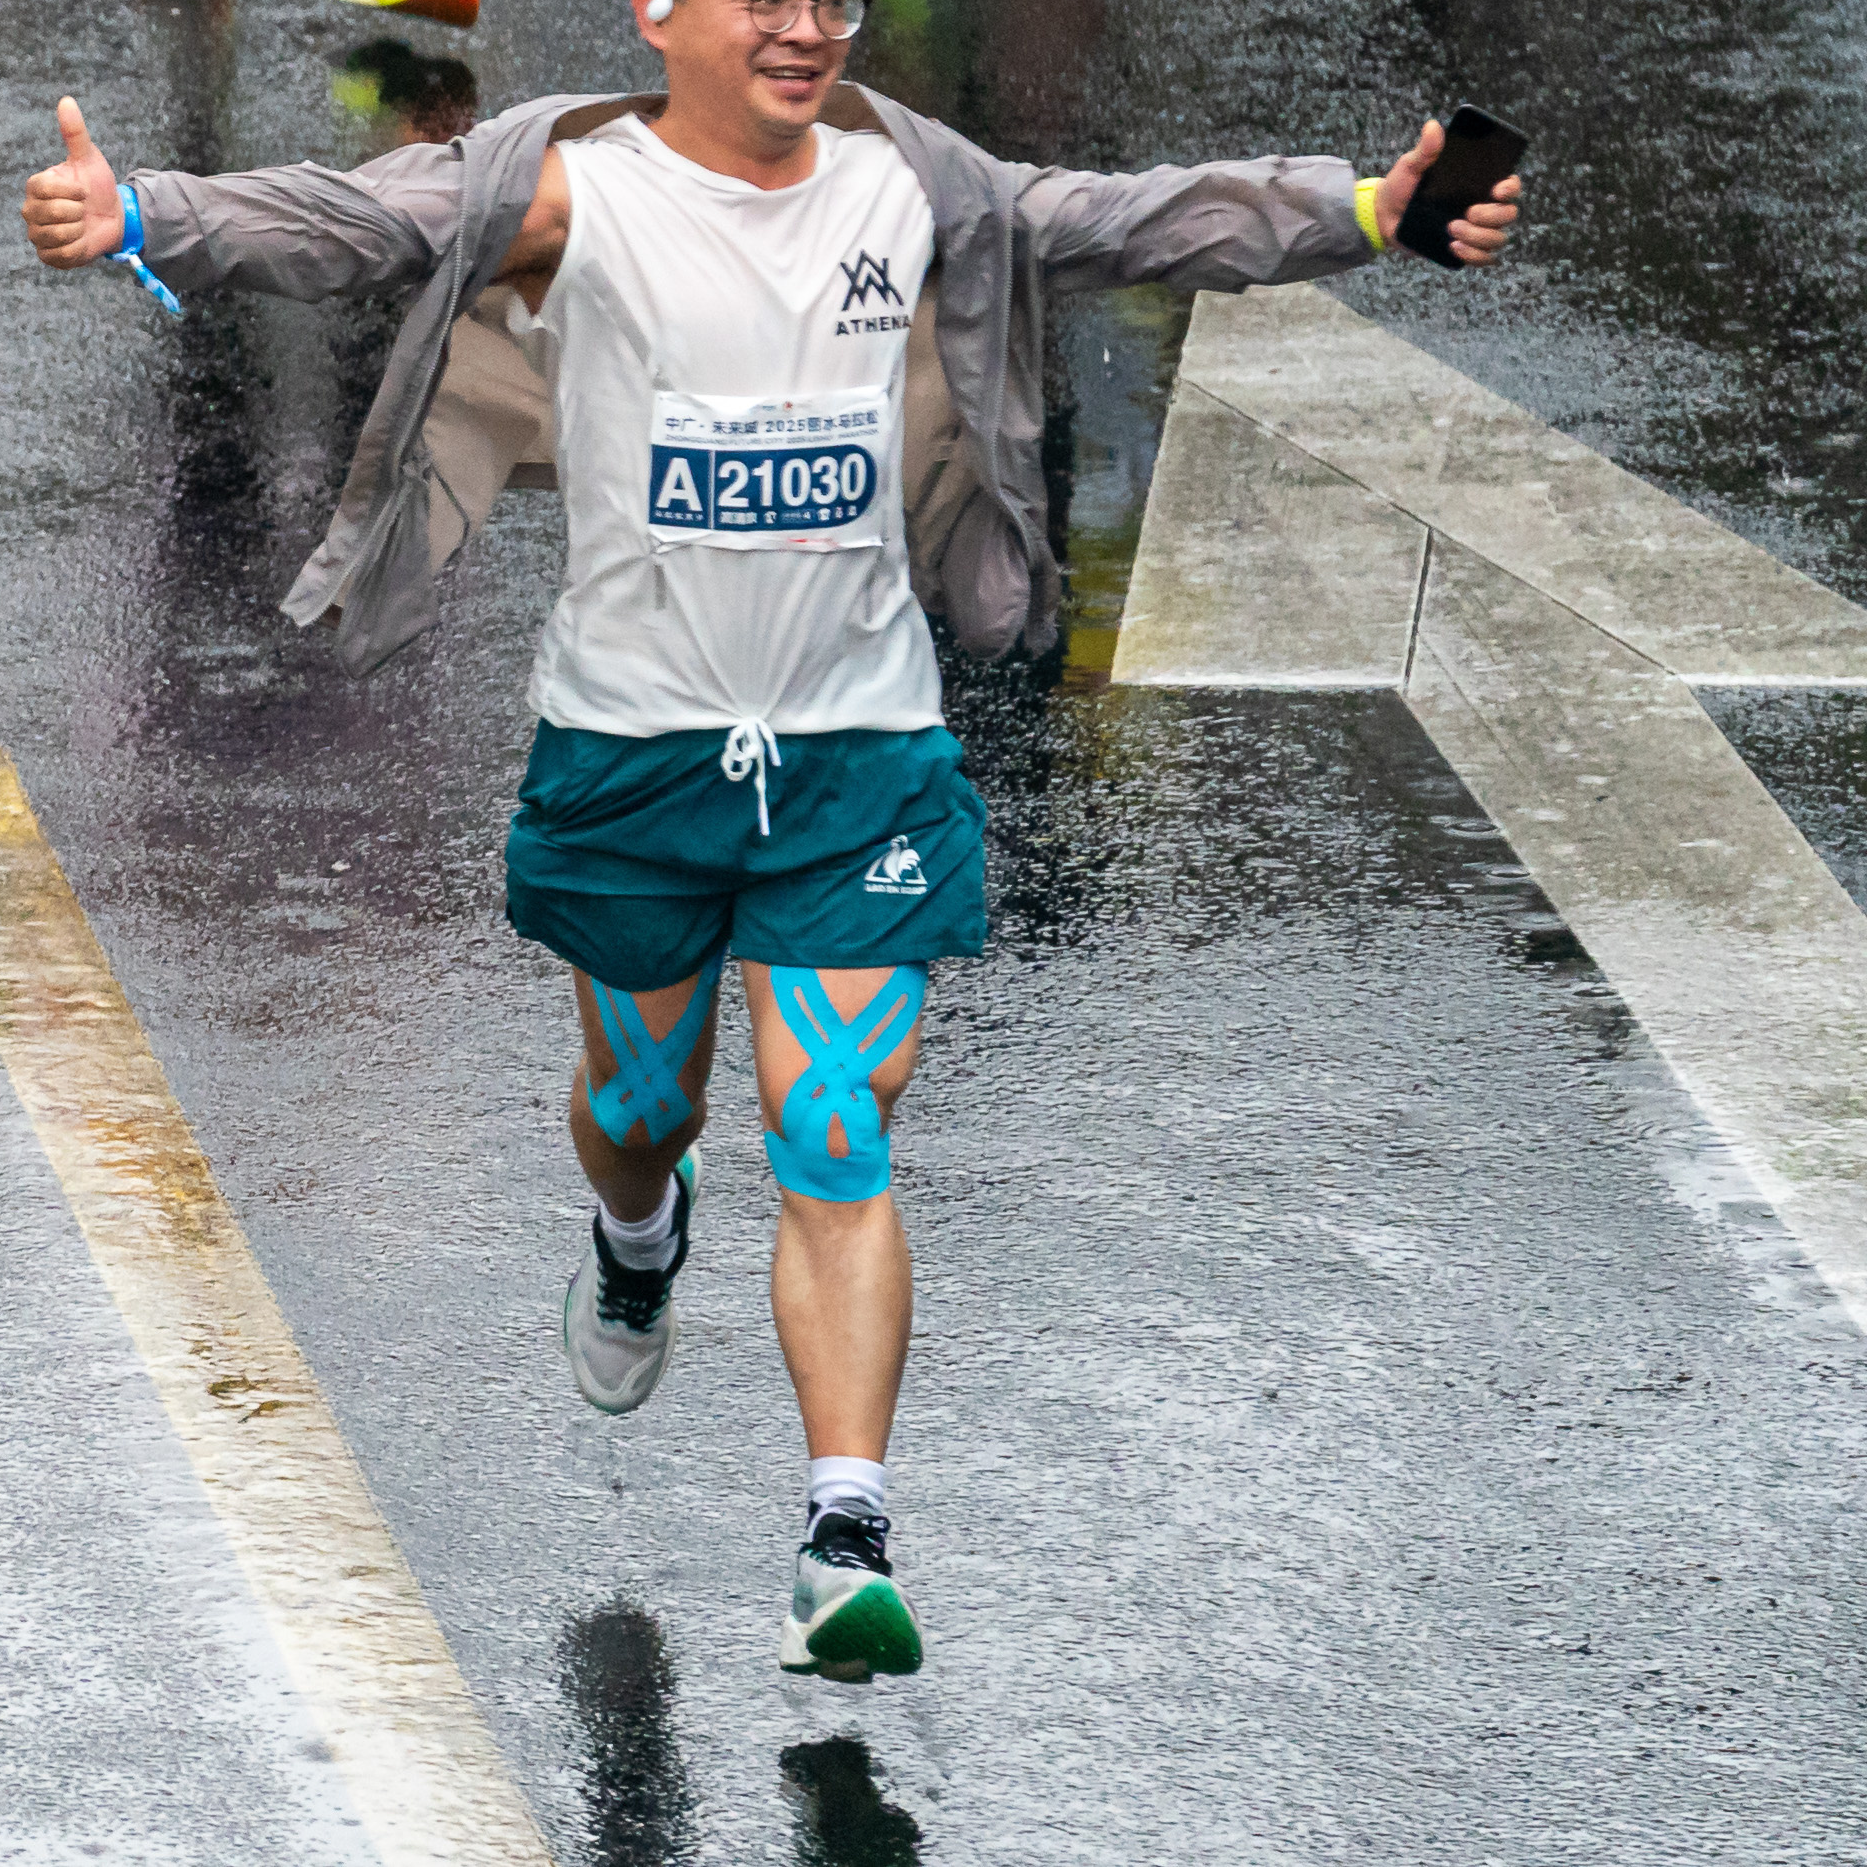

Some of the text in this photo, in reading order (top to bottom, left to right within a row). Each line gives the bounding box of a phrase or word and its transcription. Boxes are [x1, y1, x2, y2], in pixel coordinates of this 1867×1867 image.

[835, 315, 911, 336] ATHENA
[656, 453, 867, 511] A 21030
